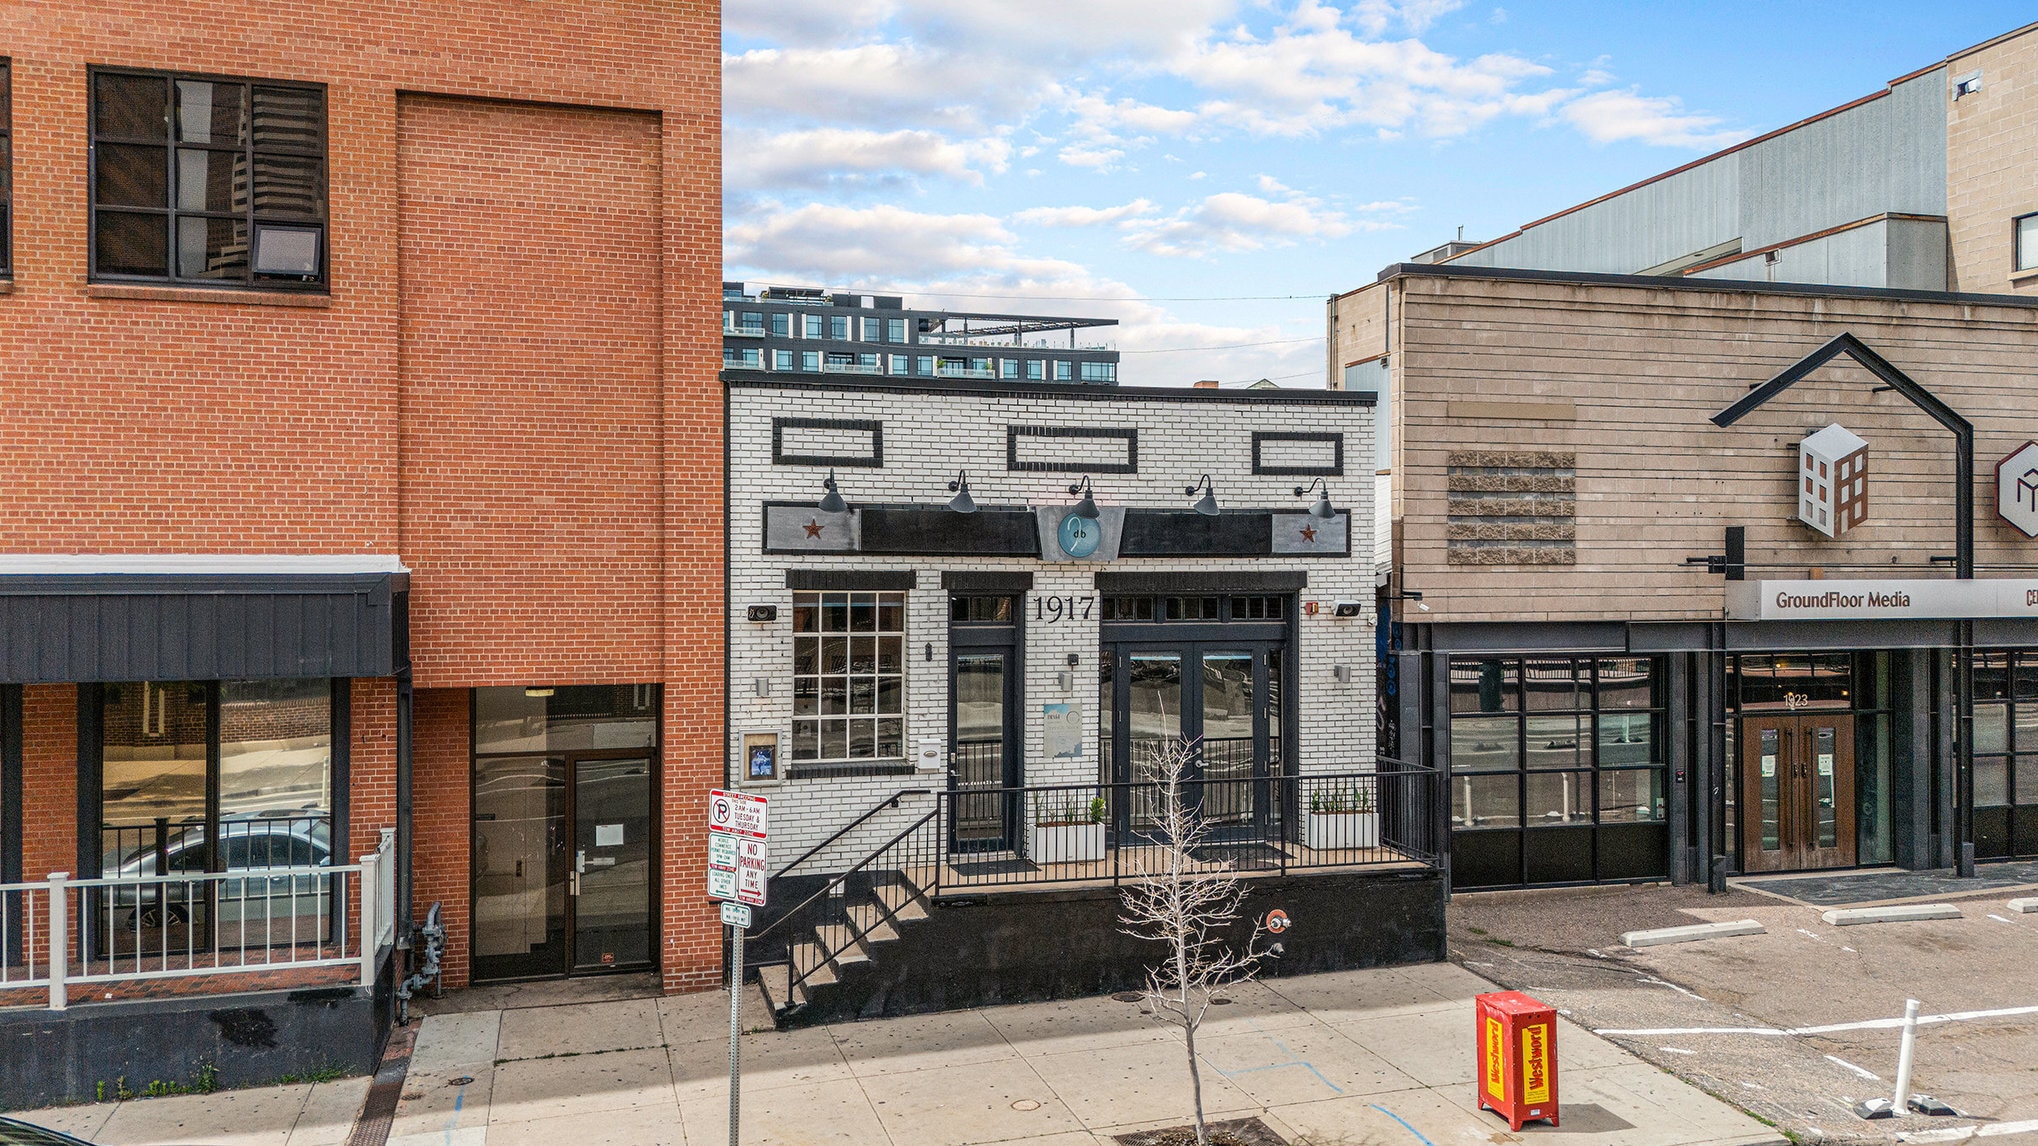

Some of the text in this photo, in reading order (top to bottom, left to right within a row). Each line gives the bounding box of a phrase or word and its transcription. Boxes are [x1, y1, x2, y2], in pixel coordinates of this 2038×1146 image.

[1776, 591, 1911, 608] GroundFloor Media
[2026, 589, 2038, 606] CE
[1033, 595, 1094, 624] 1917
[1783, 694, 1808, 707] 1923
[735, 812, 754, 821] TUESDAY
[735, 821, 758, 830] THURSDAY
[747, 843, 757, 856] NO
[740, 856, 764, 871] PARKING
[746, 870, 758, 880] ANY
[745, 879, 758, 889] TIME
[1490, 1021, 1500, 1084] Westword
[1528, 1026, 1543, 1090] Westword
